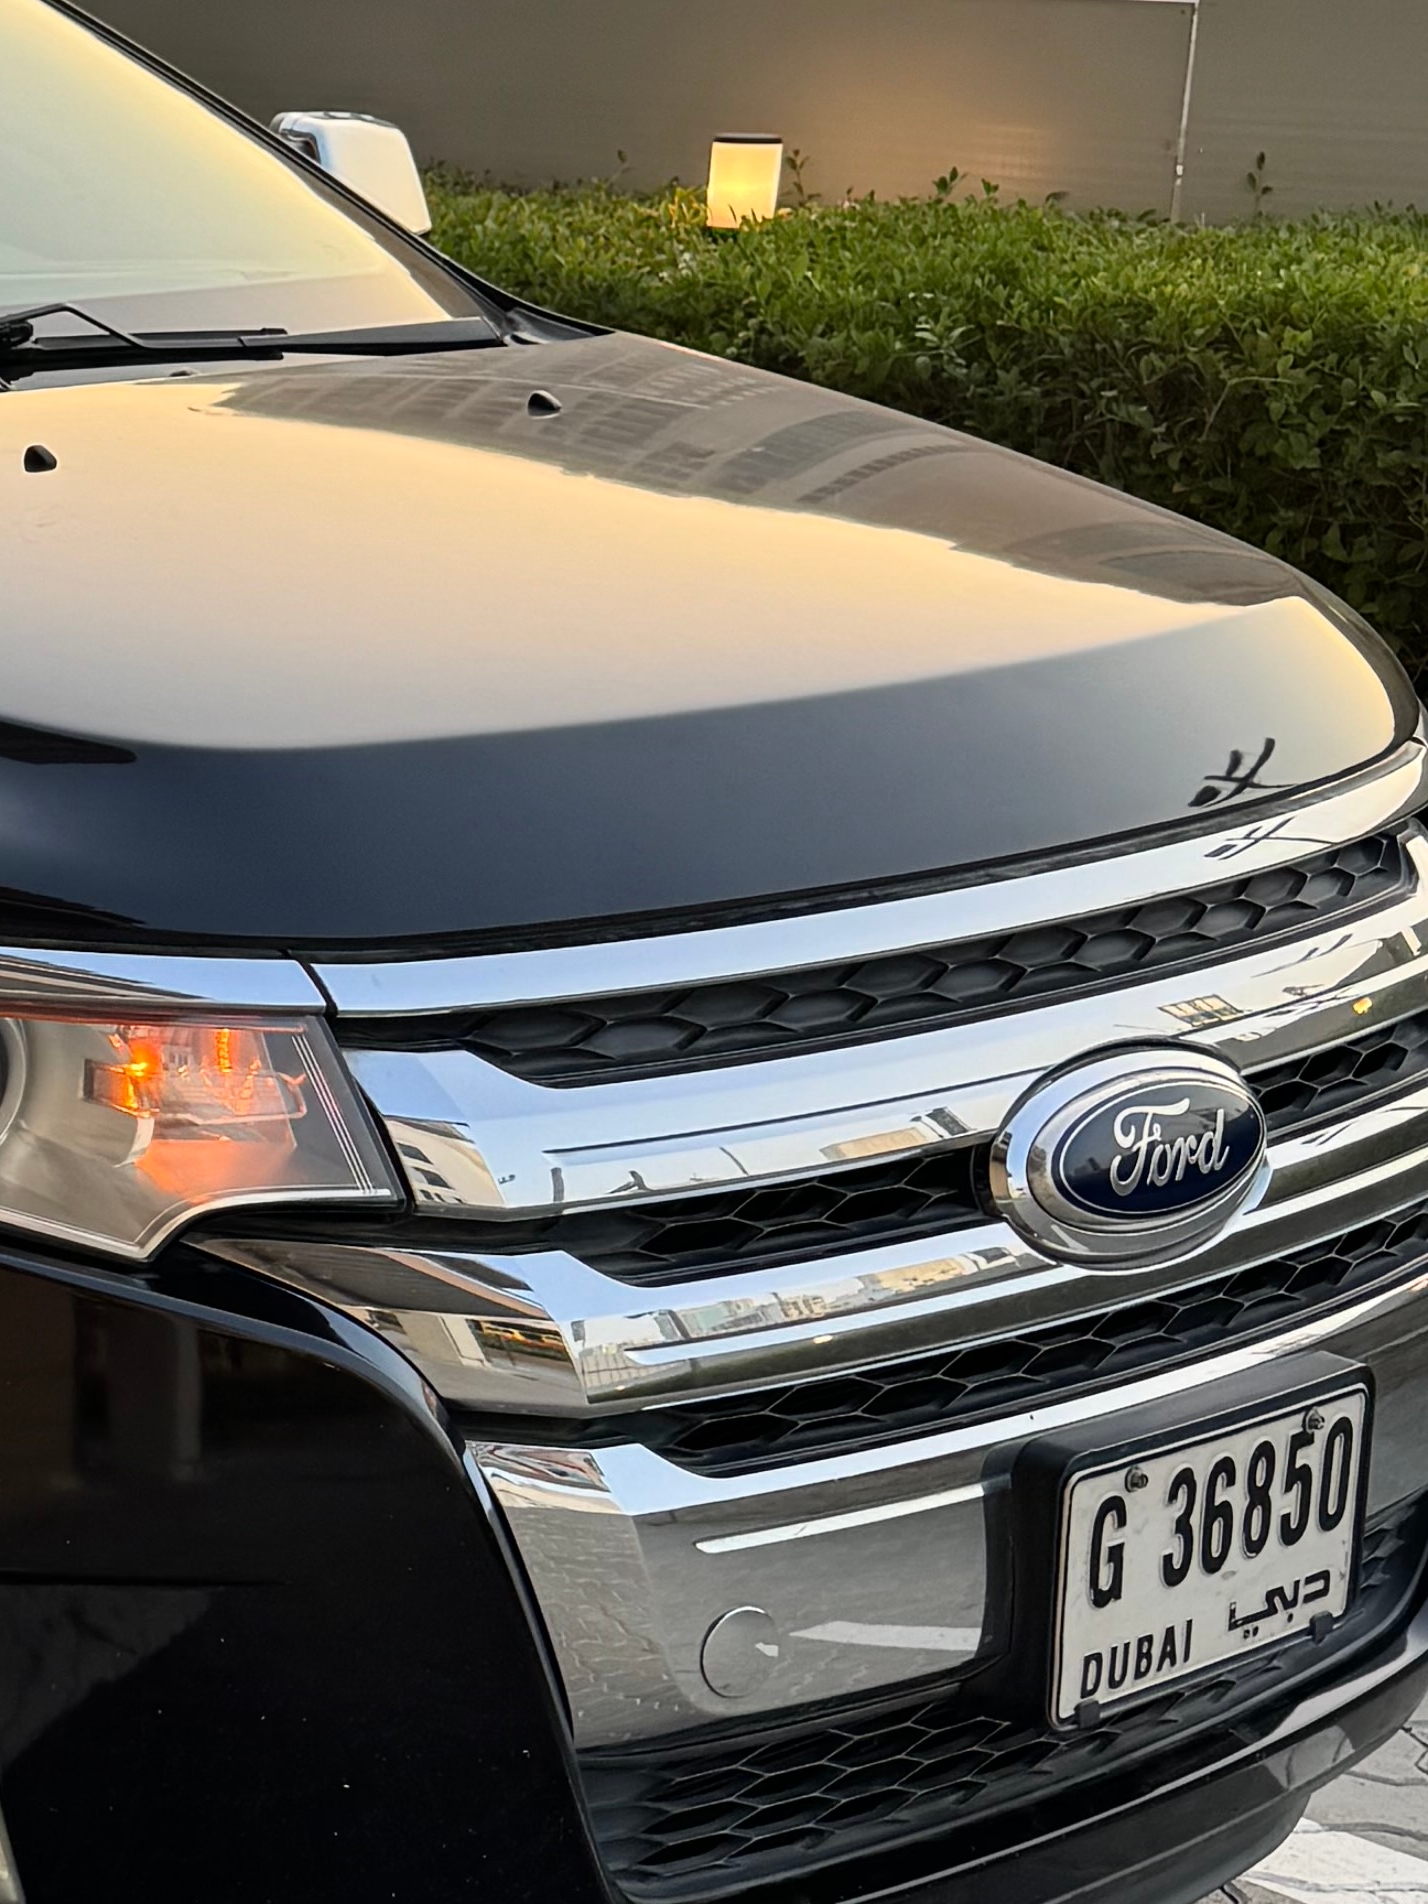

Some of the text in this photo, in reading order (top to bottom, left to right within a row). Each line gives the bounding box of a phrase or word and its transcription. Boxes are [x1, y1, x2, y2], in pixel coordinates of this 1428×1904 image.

[1110, 1097, 1230, 1196] Ford
[1089, 1415, 1354, 1609] G 36850
[1228, 1569, 1331, 1639] دبي
[1080, 1618, 1193, 1699] DUBAI
